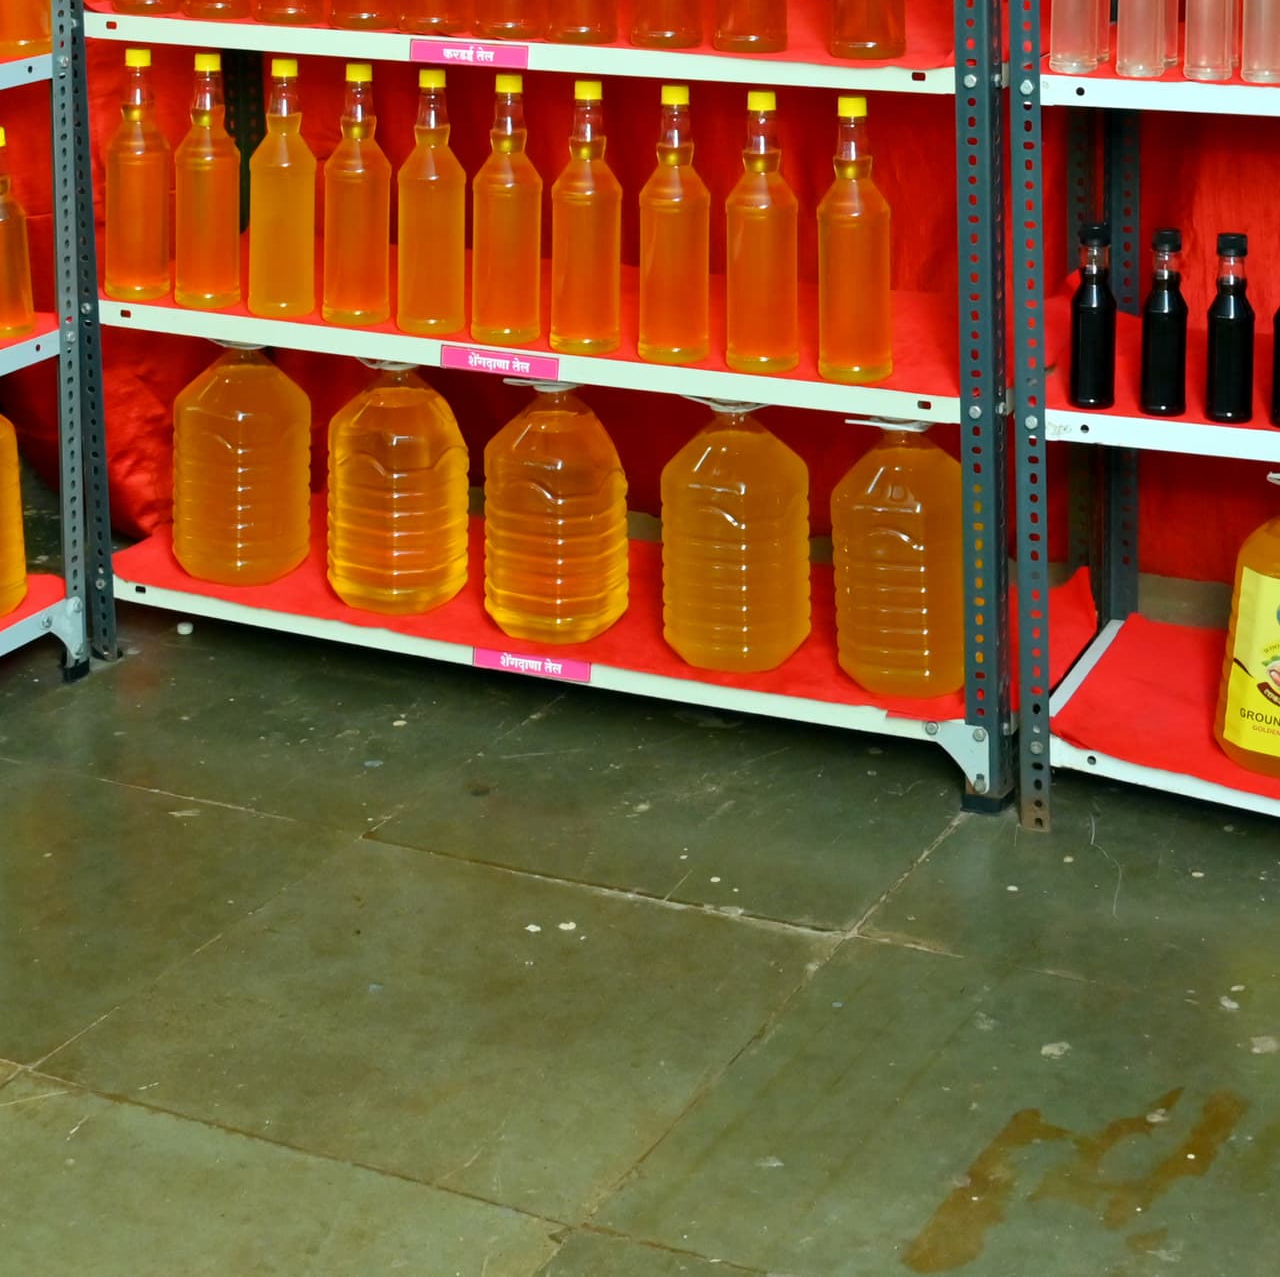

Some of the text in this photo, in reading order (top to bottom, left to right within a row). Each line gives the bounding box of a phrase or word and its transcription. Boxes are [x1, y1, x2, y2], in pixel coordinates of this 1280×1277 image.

[442, 46, 495, 63] करडई तेल
[468, 351, 531, 374] शेंगदाणा तेल
[500, 652, 563, 675] शेंगदाणा तेल
